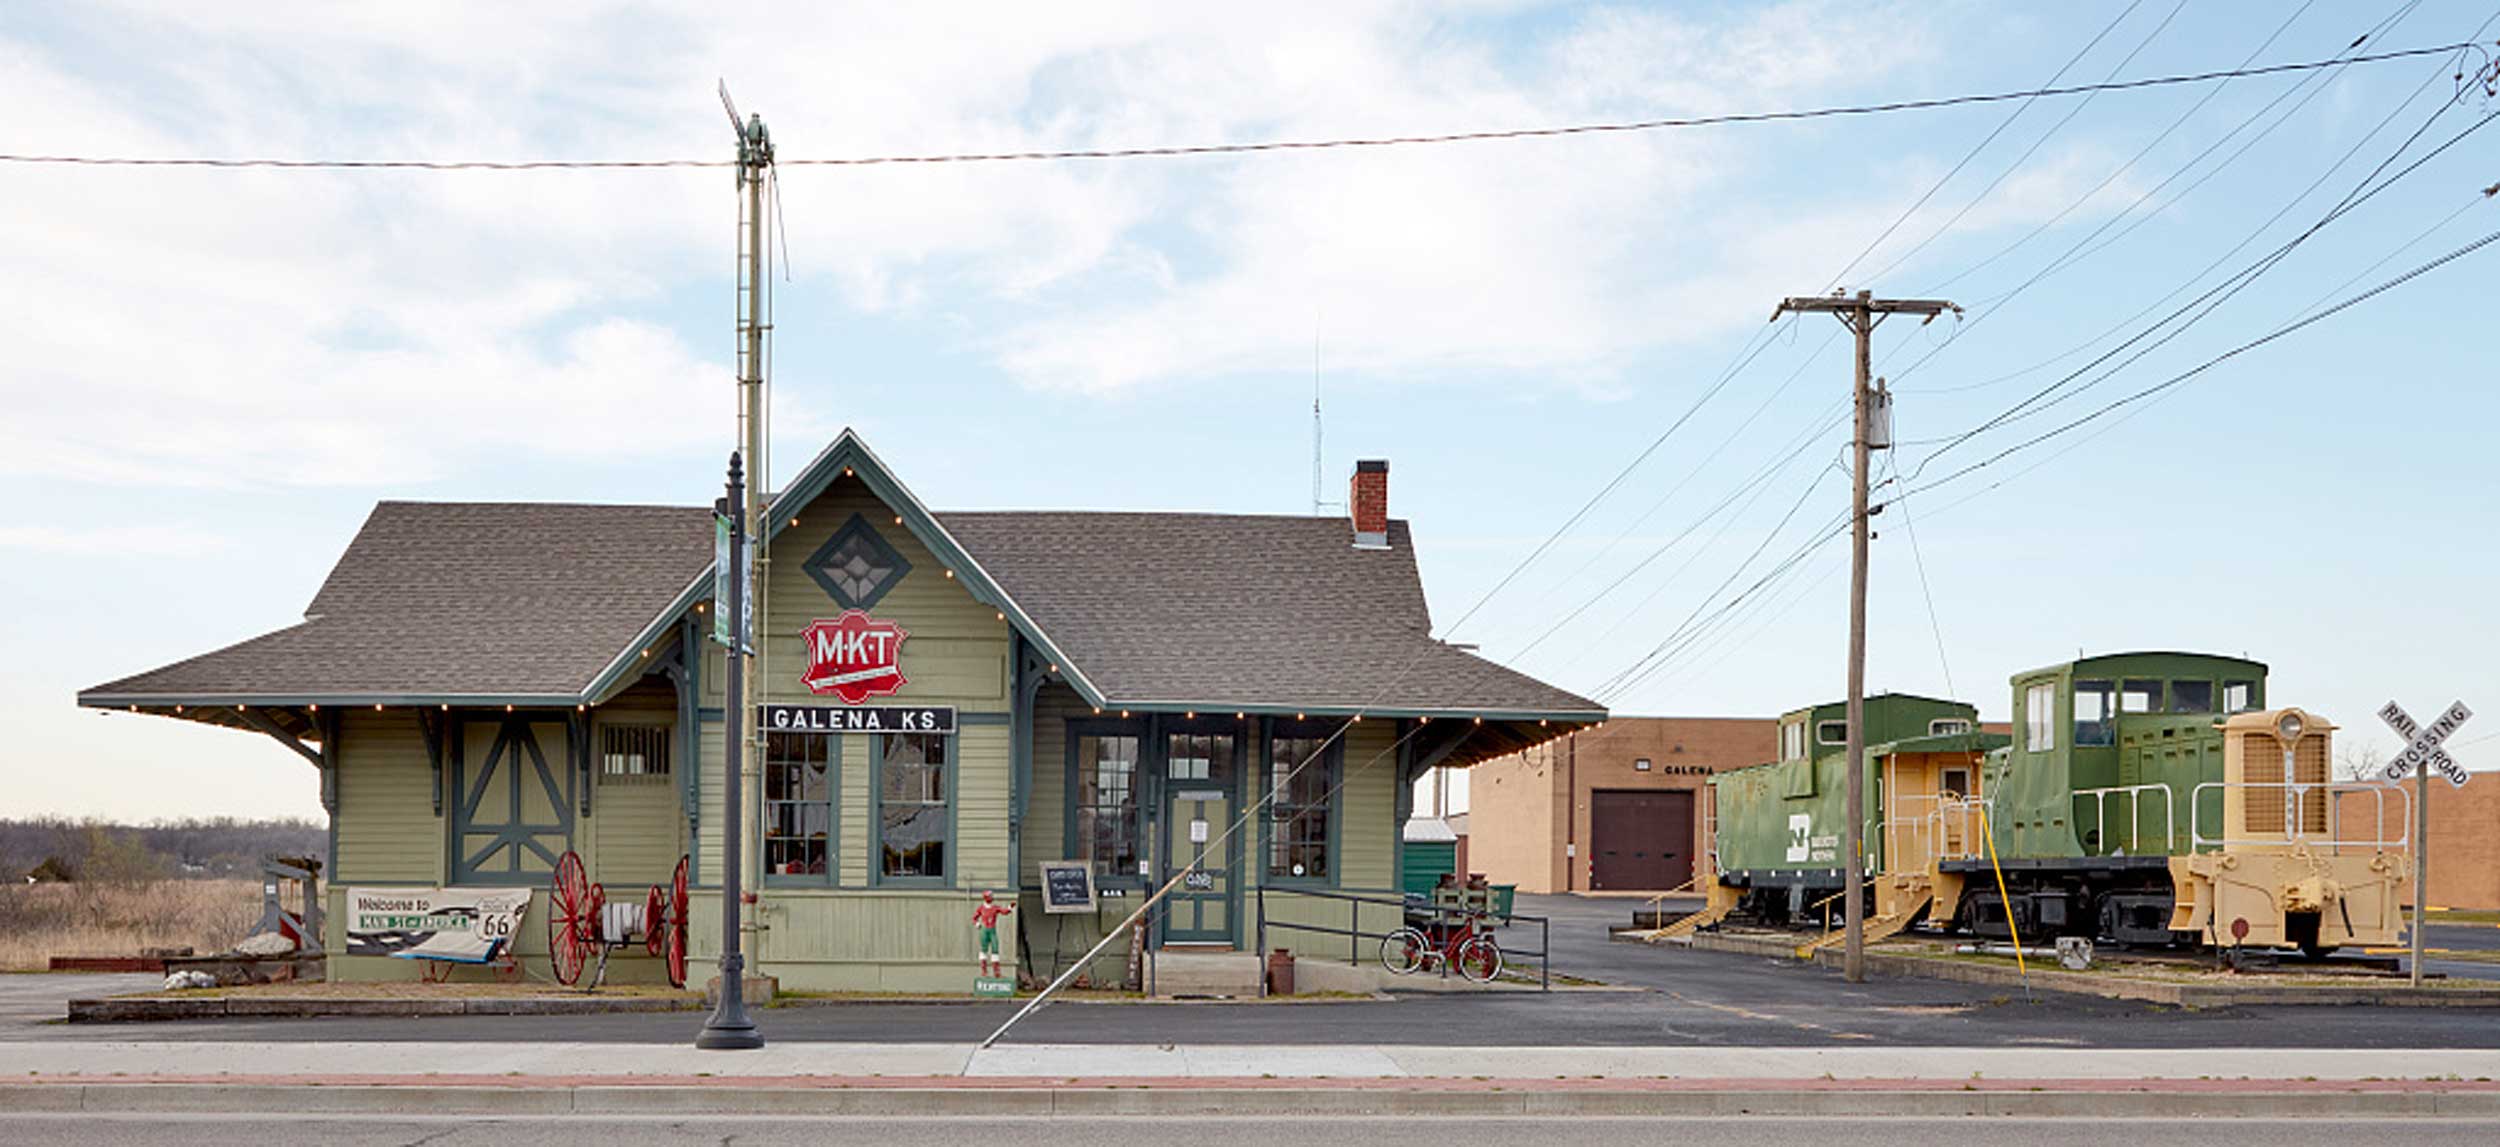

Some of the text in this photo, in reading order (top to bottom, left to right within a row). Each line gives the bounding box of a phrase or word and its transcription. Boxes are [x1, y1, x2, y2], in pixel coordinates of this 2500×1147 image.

[774, 709, 879, 729] GALENA
[2384, 705, 2466, 784] RAIL ROAD
[2386, 708, 2465, 780] CROSSING
[358, 898, 430, 911] Welcome to
[484, 914, 509, 936] 66
